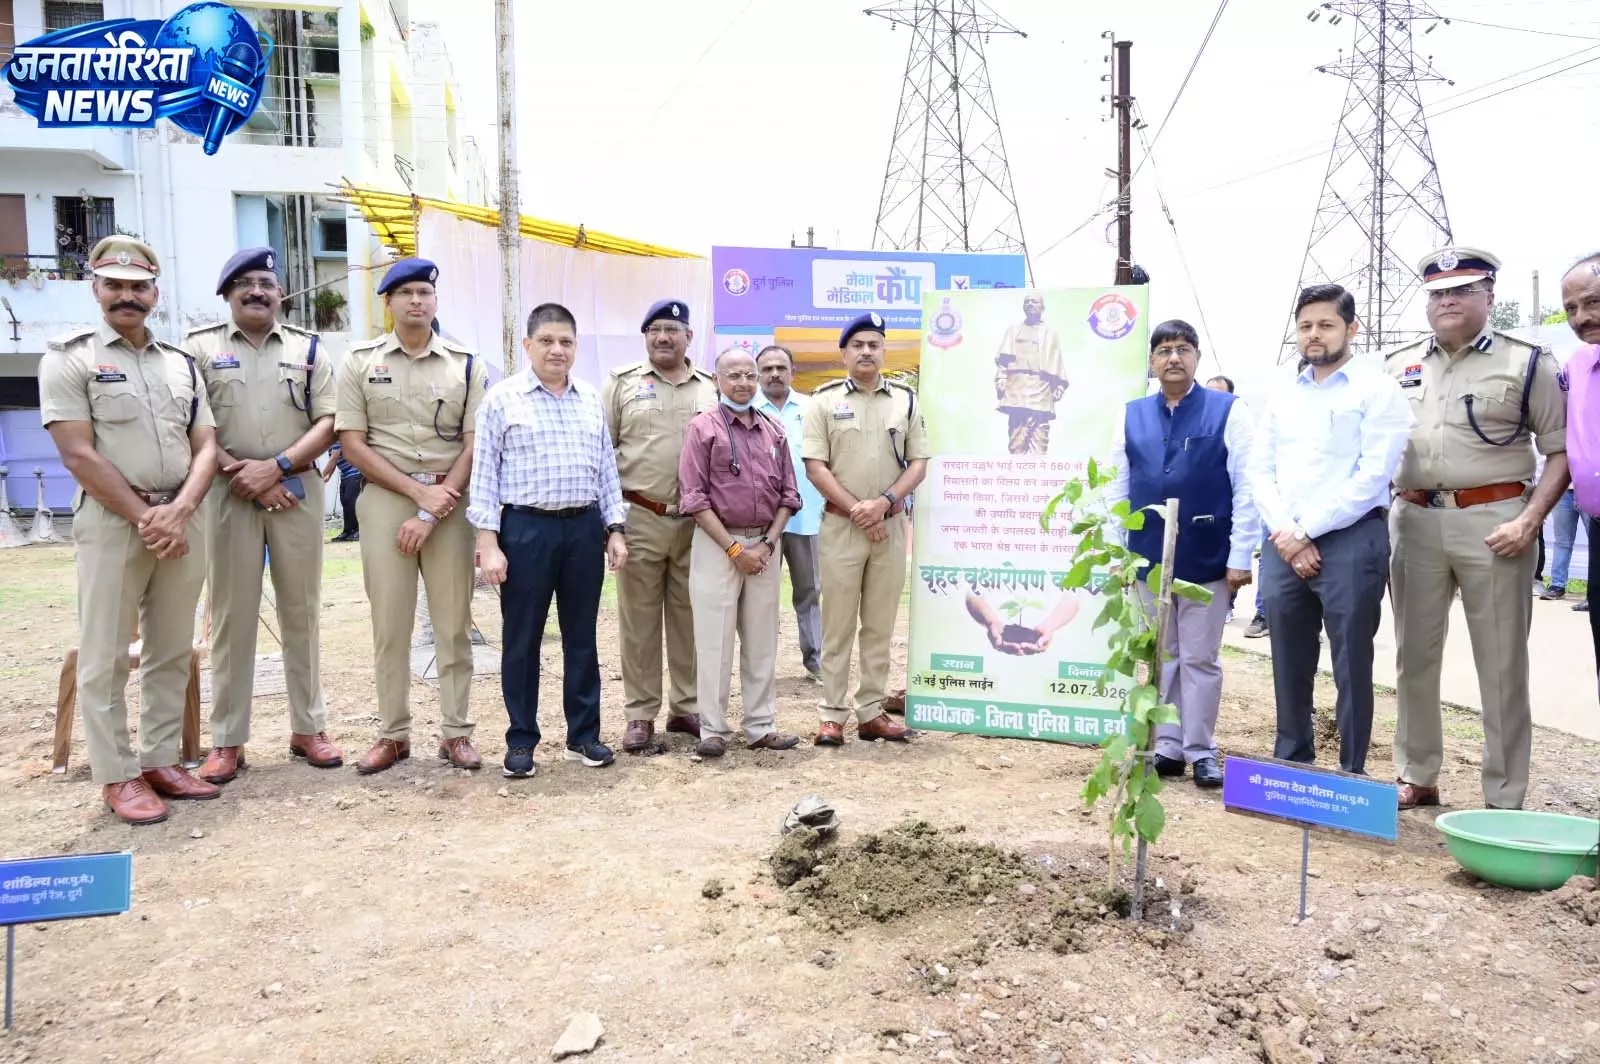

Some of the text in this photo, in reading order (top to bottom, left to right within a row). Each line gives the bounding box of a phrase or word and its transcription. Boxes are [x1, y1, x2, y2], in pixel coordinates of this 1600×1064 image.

[768, 276, 794, 290] पुलिस
[846, 270, 873, 288] मेगा
[826, 286, 874, 304] मेडिकल
[1050, 462, 1070, 471] 560
[971, 541, 993, 551] भारत
[963, 561, 1047, 596] वृक्षारोपण
[940, 659, 975, 670] स्थान
[923, 674, 936, 686] नई
[939, 675, 966, 690] पुलिस
[968, 677, 994, 691] लाईन
[985, 704, 1024, 730] जिला
[1027, 708, 1070, 737] पुलिस
[1249, 774, 1262, 785] श्री
[1263, 777, 1290, 790] अरुण
[1264, 790, 1287, 801] पुलिस
